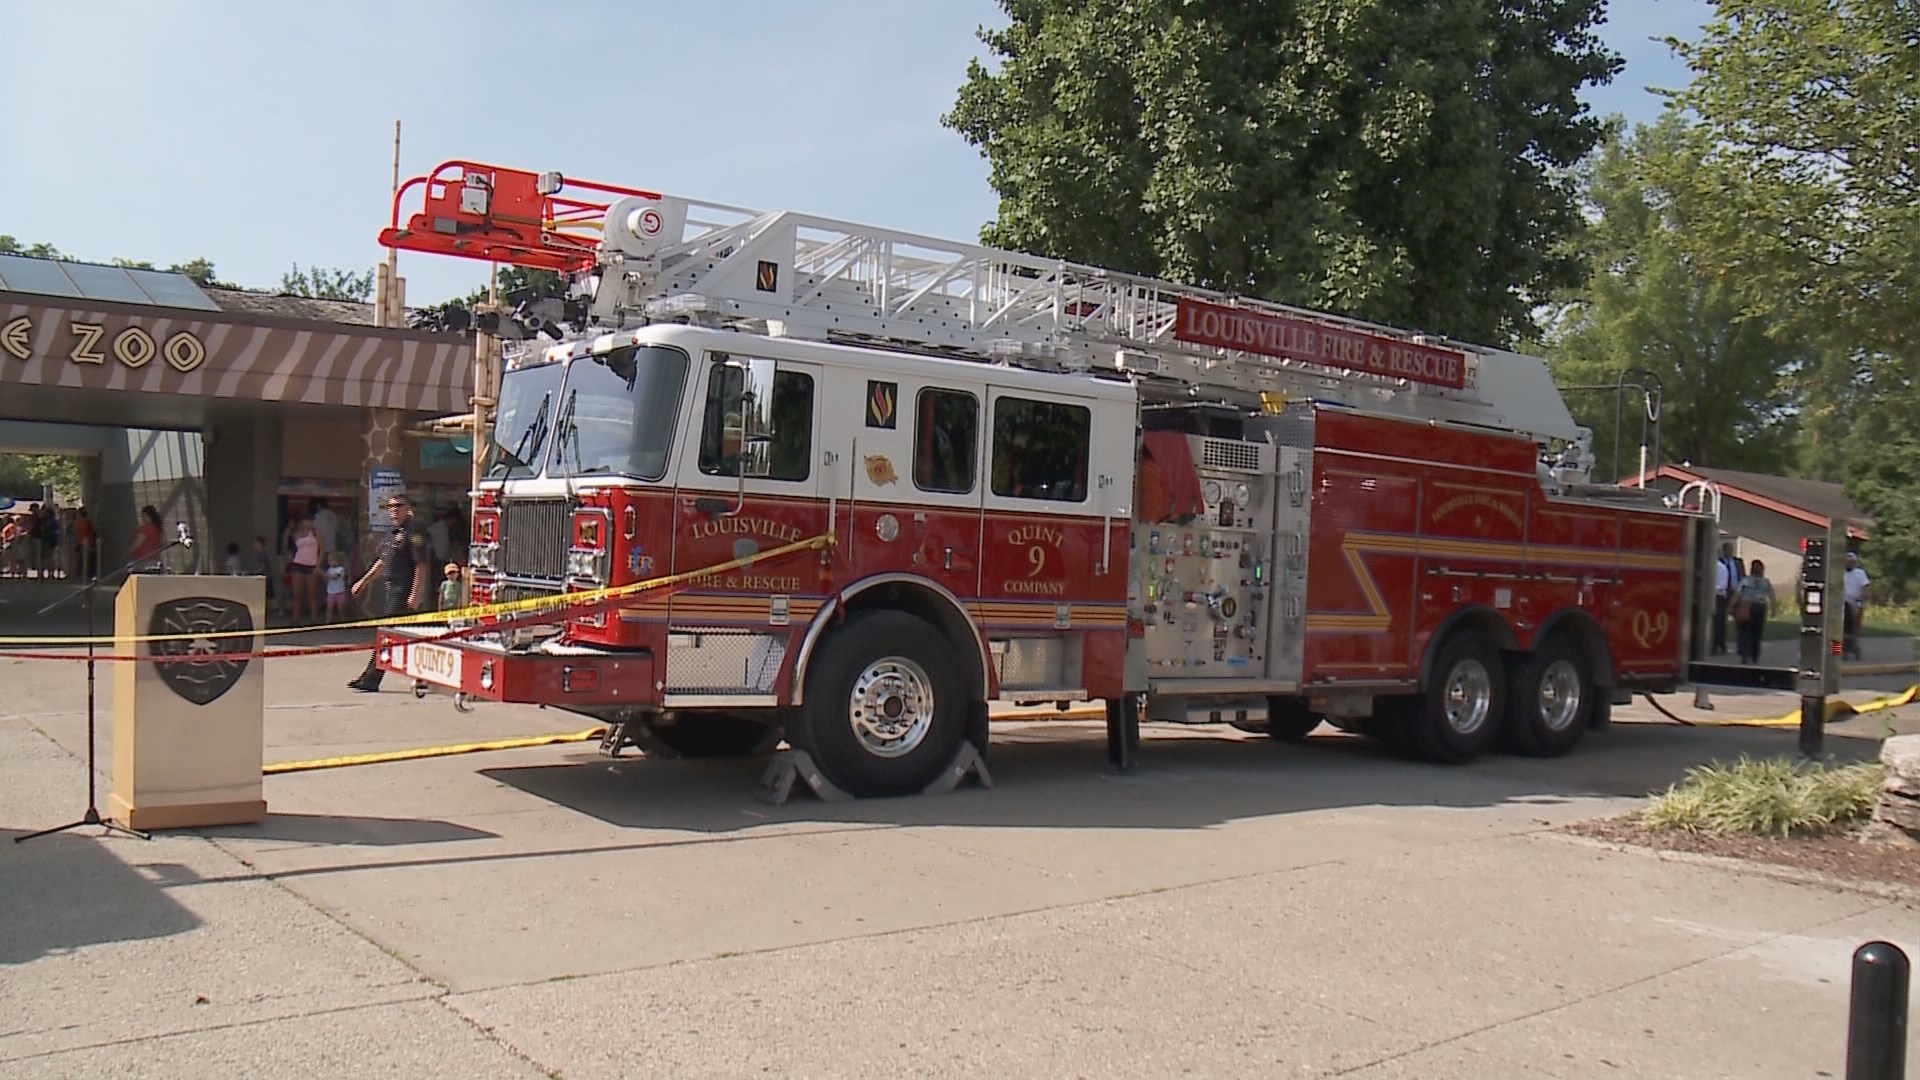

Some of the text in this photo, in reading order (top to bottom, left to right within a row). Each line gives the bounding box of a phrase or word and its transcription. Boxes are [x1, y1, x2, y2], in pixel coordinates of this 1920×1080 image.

[70, 321, 206, 373] ZOO
[1187, 307, 1459, 382] LOUISVILLE FIRE & RESCUE
[691, 517, 802, 542] LOUISVILLE
[1008, 526, 1066, 548] QUINT
[1028, 545, 1045, 577] 9
[725, 577, 737, 589] &
[743, 576, 800, 591] RESCUE
[1003, 580, 1066, 595] COMPANY
[1632, 609, 1669, 649] Q-9
[413, 645, 455, 678] QUINT 9
